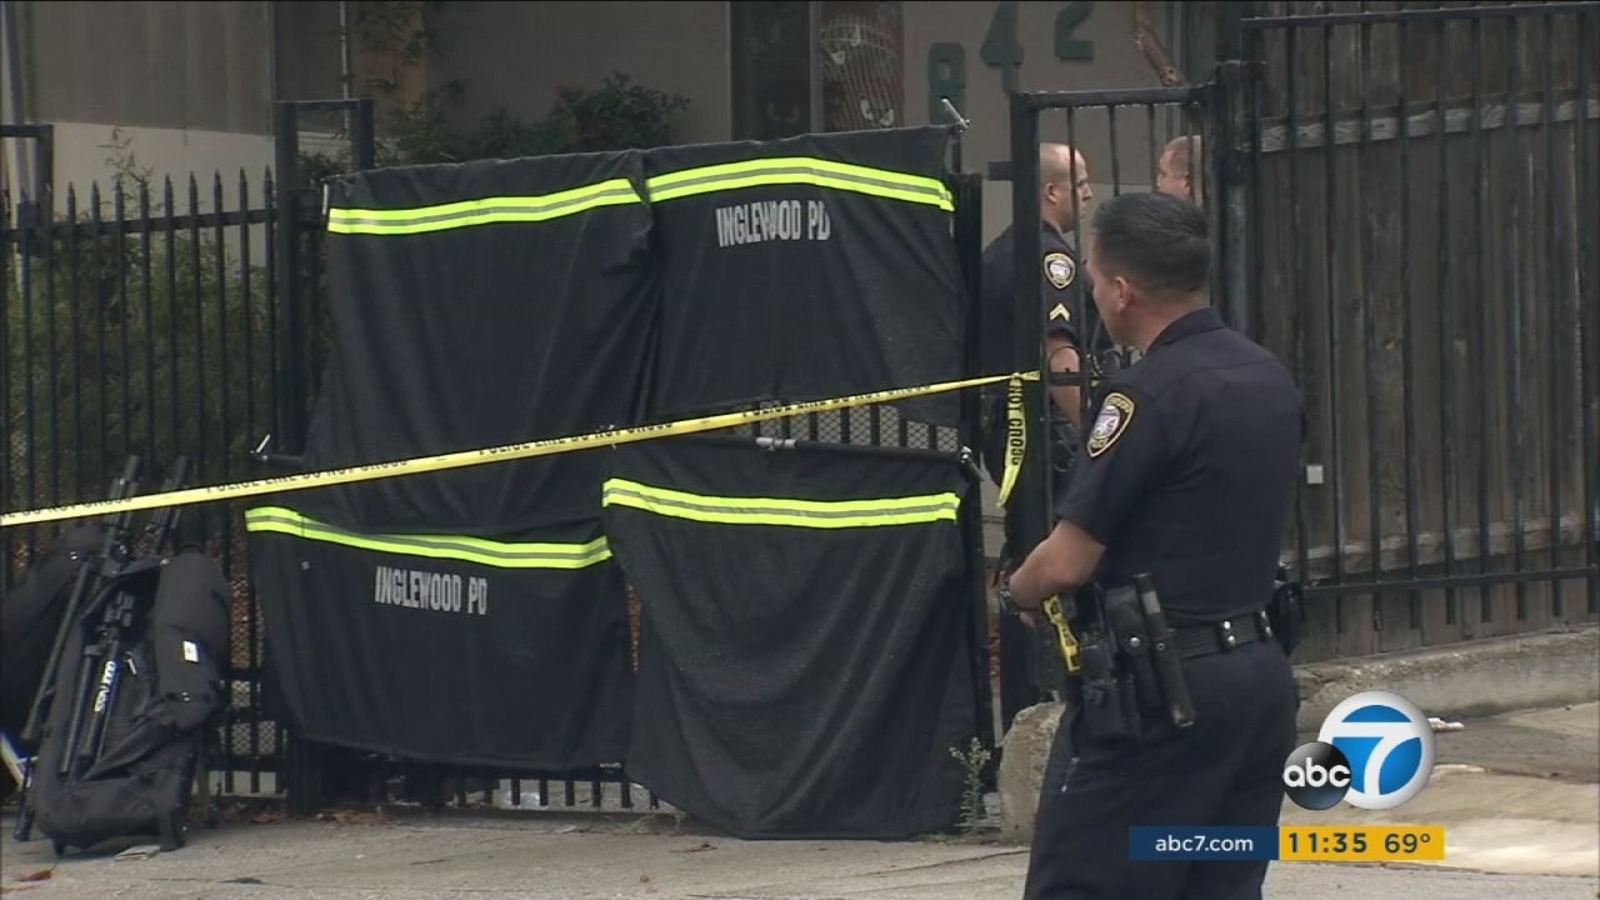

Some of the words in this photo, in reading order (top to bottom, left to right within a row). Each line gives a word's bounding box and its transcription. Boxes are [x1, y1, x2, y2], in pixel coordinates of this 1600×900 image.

[715, 200, 802, 247] INGLEWOOD
[807, 199, 831, 241] PD
[374, 566, 462, 613] INGLEWOOD
[468, 576, 488, 615] PD
